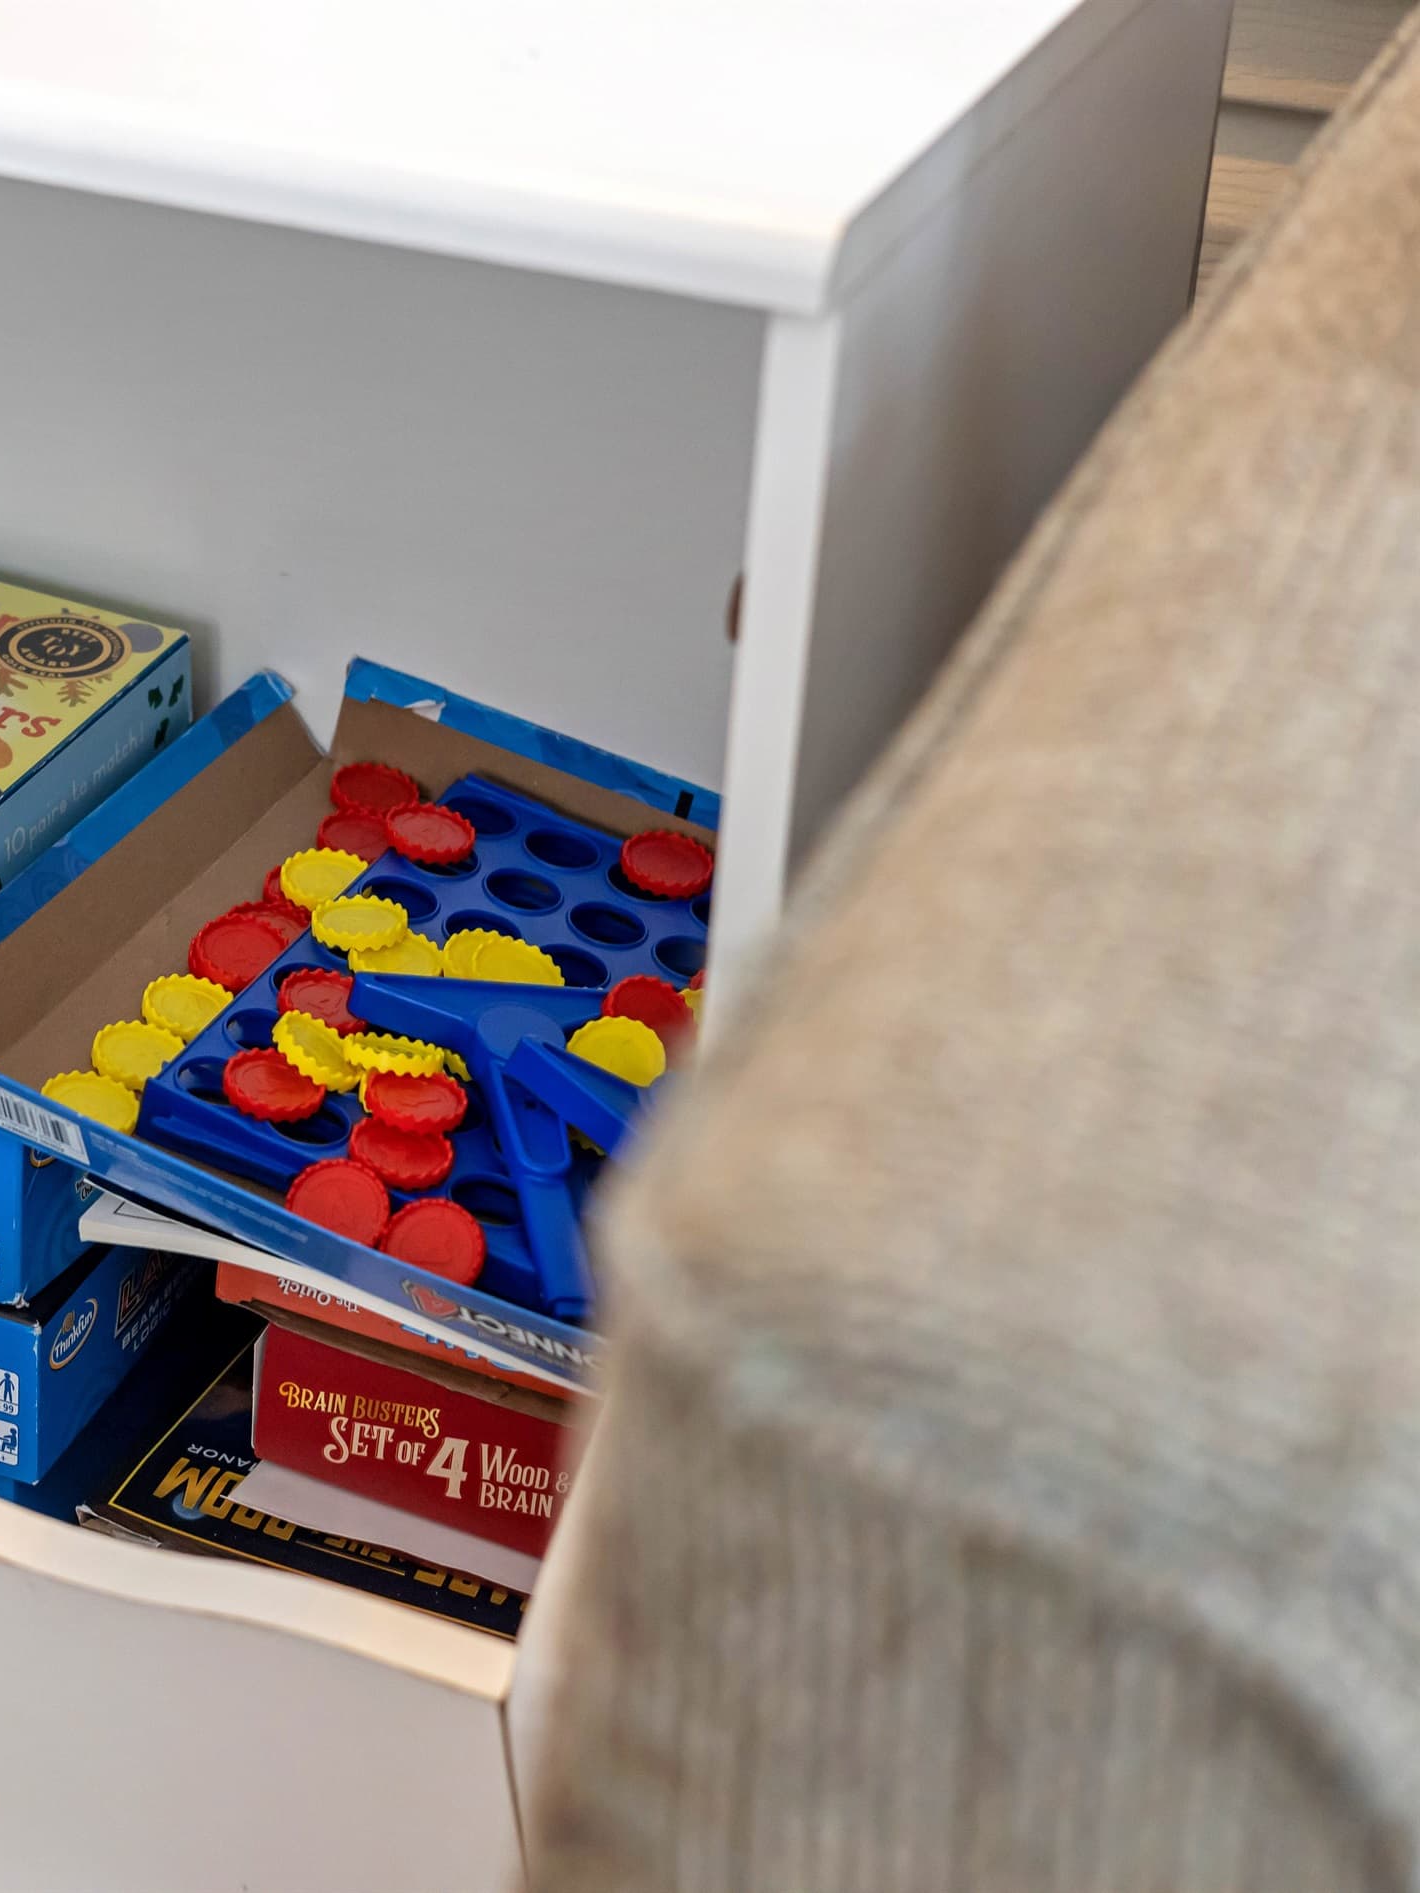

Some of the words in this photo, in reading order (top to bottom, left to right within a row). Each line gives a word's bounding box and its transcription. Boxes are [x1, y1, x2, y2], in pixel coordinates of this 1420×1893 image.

[20, 647, 70, 667] AWARD
[4, 826, 26, 862] 10
[426, 1436, 470, 1499] 4
[479, 1481, 553, 1518] BRAIN
